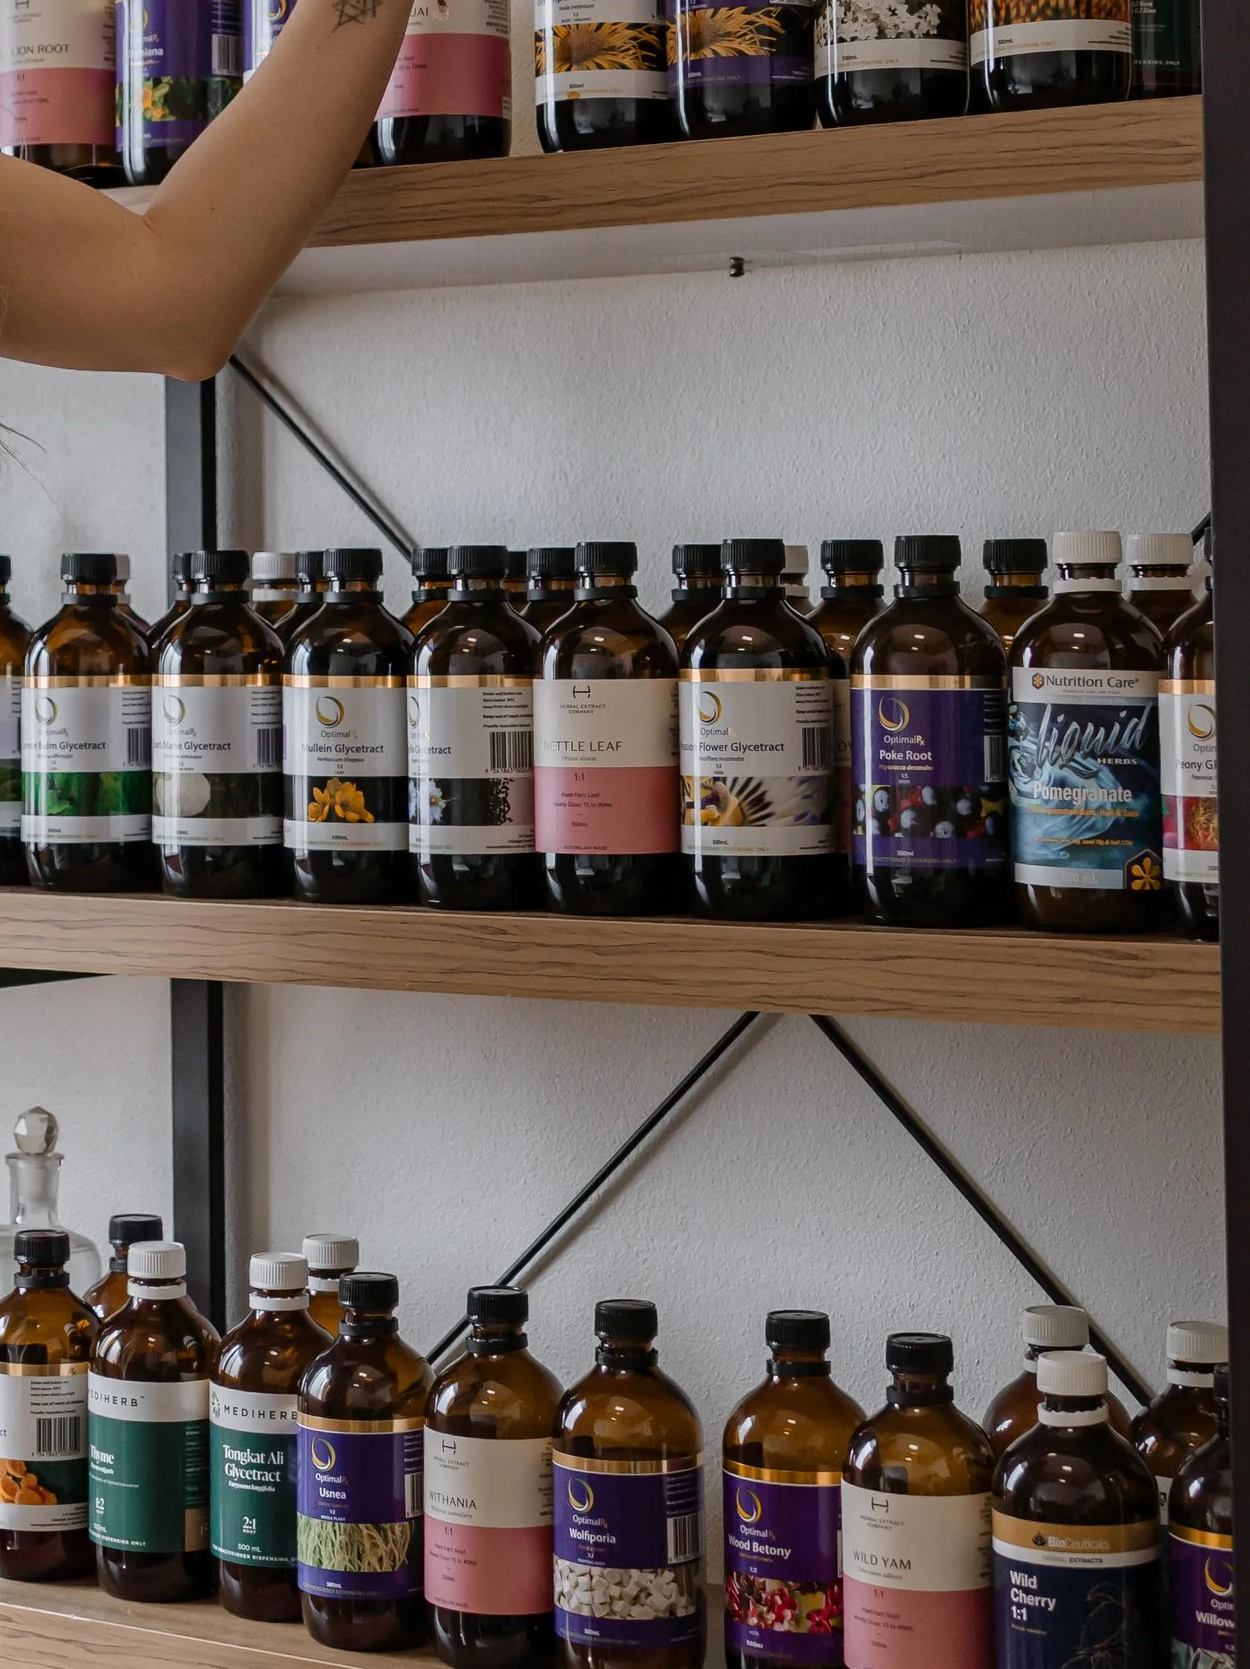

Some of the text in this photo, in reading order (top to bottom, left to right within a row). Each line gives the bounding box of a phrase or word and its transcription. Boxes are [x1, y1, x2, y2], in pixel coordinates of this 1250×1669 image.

[410, 7, 429, 17] UAI
[37, 43, 70, 54] ROOT
[1047, 675, 1102, 687] Nutrition
[700, 728, 728, 737] Optimal
[59, 740, 106, 753] Glycetract
[544, 740, 623, 752] NETTLE LEAF
[883, 734, 925, 746] OptimalRx
[184, 741, 231, 753] Glycetract
[302, 743, 384, 755] ullein Glycetract
[699, 741, 785, 754] Flower Glycetract
[1193, 743, 1217, 755] Opti
[879, 749, 932, 761] Poke Root
[1097, 757, 1138, 765] HERBS
[574, 772, 585, 781] 1:1
[1033, 781, 1133, 805] Pomegranate
[224, 1405, 297, 1419] MEDIHERB
[90, 1444, 115, 1465] Thyme
[222, 1444, 284, 1465] Tongkat Ali
[447, 1458, 469, 1467] EXTRACT
[224, 1462, 281, 1482] Glycetract
[319, 1487, 347, 1500] Usnea
[429, 1490, 477, 1510] WITHANIA
[95, 1497, 105, 1510] 1:2
[242, 1516, 257, 1530] 2:1
[879, 1518, 905, 1526] EXTRACT
[569, 1527, 616, 1544] Wolfiporia
[237, 1543, 261, 1553] 500 mL
[728, 1534, 791, 1560] Wood Betony
[1047, 1535, 1109, 1550] BioCeuticals
[252, 1554, 289, 1562] DISPENSING
[852, 1549, 912, 1570] WILD YAM
[1010, 1570, 1038, 1589] Wild
[873, 1588, 884, 1599] 1:1
[1010, 1587, 1056, 1611] Cherry
[1210, 1598, 1233, 1611] Opti
[1011, 1605, 1027, 1621] 1:1
